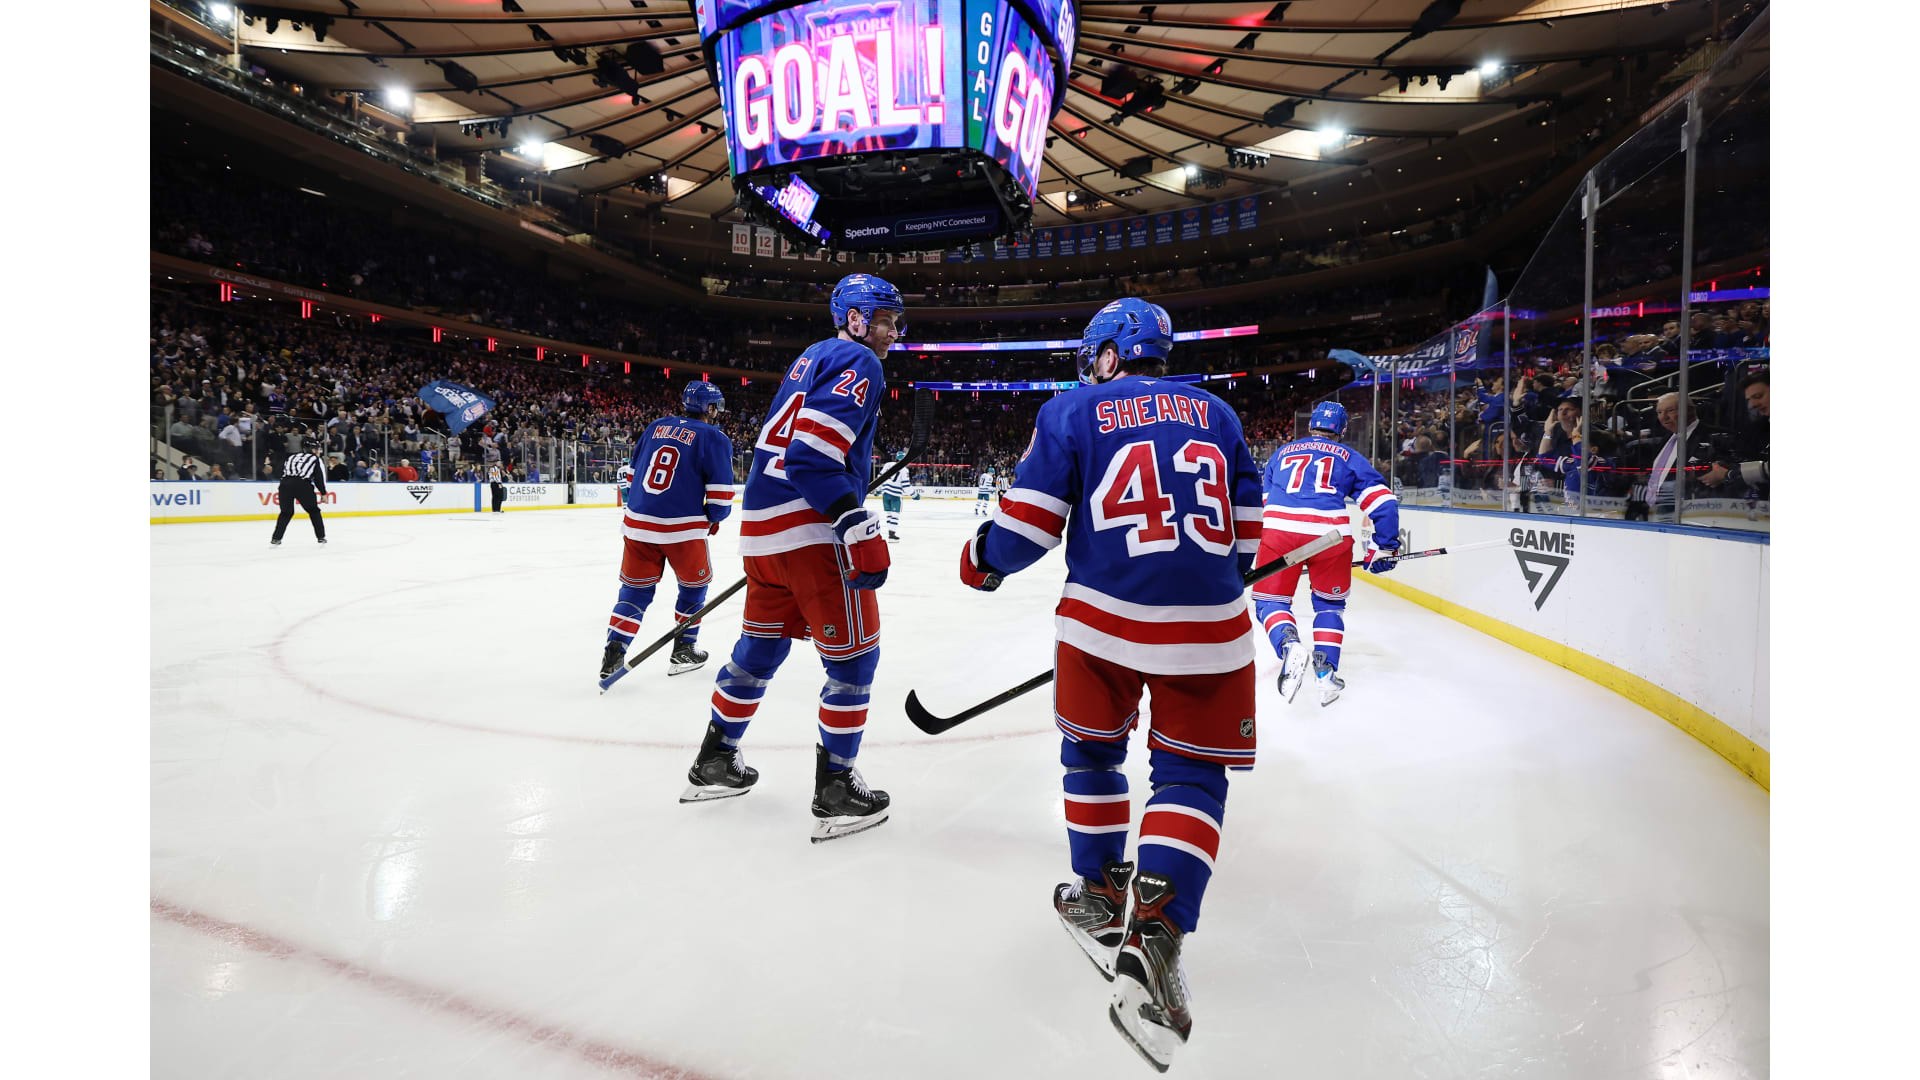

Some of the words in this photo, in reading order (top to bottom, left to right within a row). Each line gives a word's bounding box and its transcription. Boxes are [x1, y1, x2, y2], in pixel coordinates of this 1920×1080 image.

[972, 12, 992, 122] GOAL
[735, 26, 944, 150] GOAL!
[845, 227, 885, 239] Spectrum
[905, 221, 932, 231] Keeping
[932, 218, 948, 228] NYC
[948, 216, 986, 226] Connected
[735, 233, 748, 245] 10
[759, 236, 772, 248] 12
[831, 369, 870, 407] 24
[1096, 394, 1209, 433] SHEARY
[652, 425, 697, 446] MILLER
[642, 444, 681, 495] 8
[1280, 454, 1337, 494] 71
[151, 489, 200, 506] well
[509, 486, 546, 495] CAESARS
[1090, 438, 1236, 557] 43
[1510, 528, 1574, 556] GAME
[1140, 876, 1166, 886] CCM
